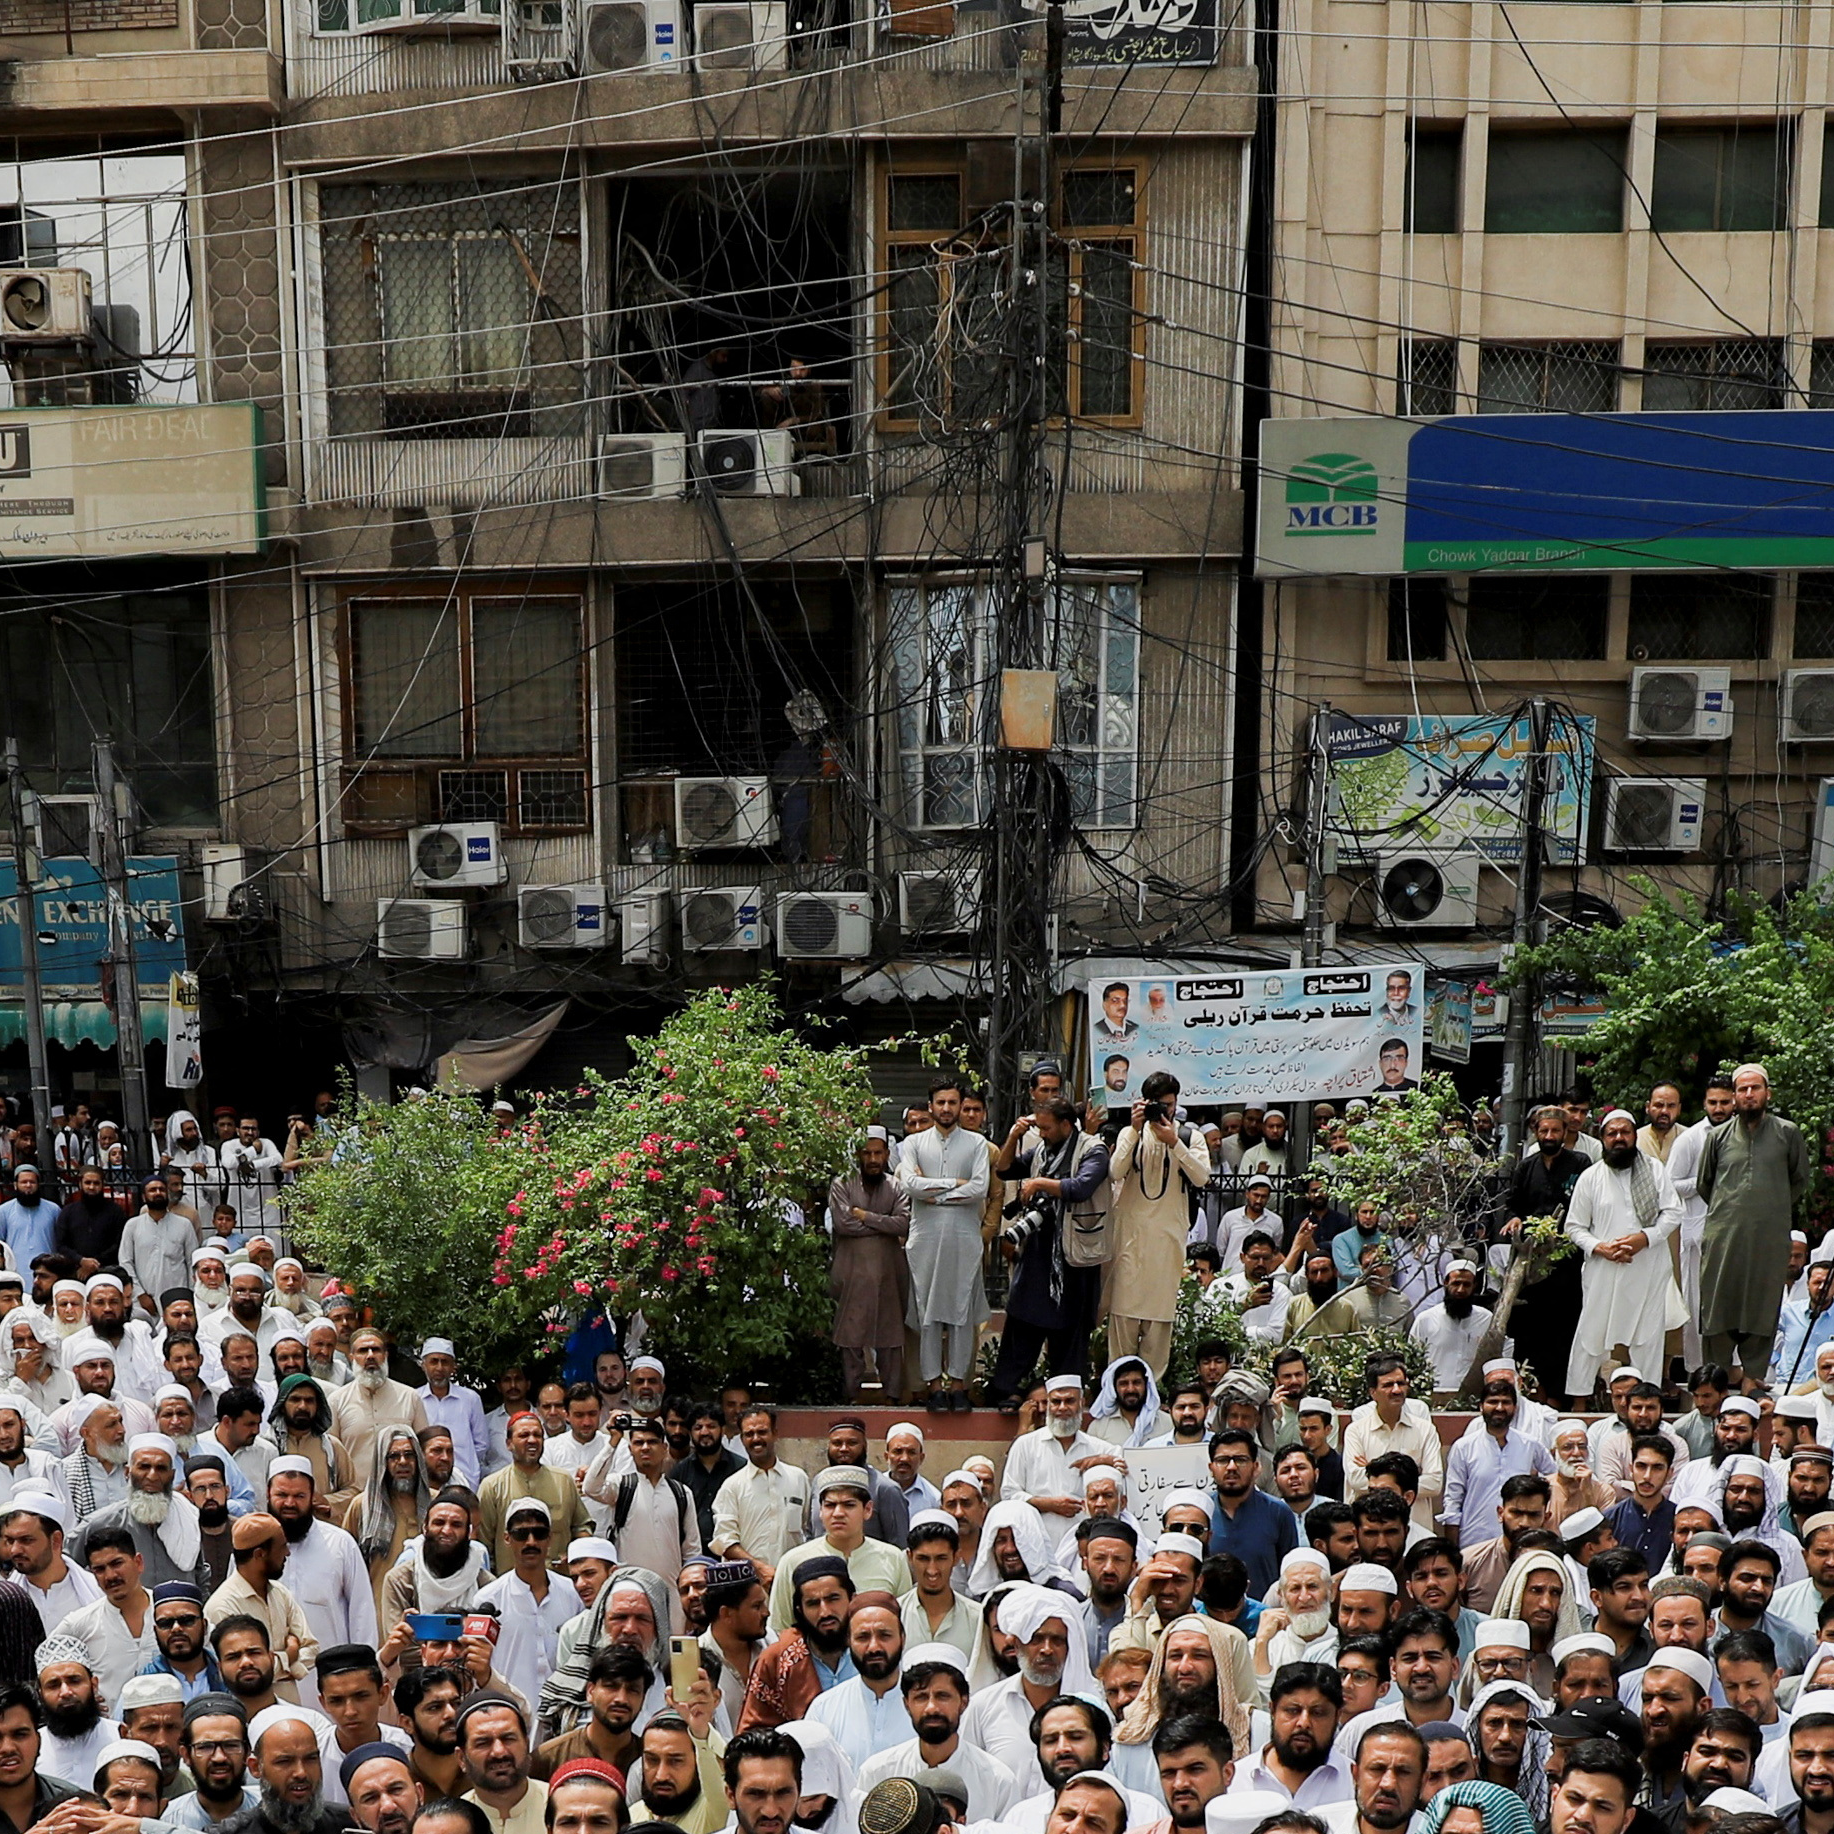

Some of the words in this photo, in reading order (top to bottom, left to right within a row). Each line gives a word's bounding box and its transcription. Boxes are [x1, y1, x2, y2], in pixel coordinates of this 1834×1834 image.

[81, 416, 137, 441] FAIR
[1286, 505, 1378, 528] MCB
[1427, 548, 1477, 563] Chowk
[1482, 548, 1531, 566] Yadgar
[1535, 547, 1586, 562] Branch
[1703, 697, 1722, 706] Haier
[1327, 724, 1362, 744] HAKIL
[1679, 809, 1697, 818] Haier
[468, 845, 490, 855] Haier
[44, 899, 173, 925] EXCHNGE
[1179, 981, 1240, 999] احتجاج
[1306, 974, 1368, 994] احتجاج
[1184, 1008, 1224, 1028] ریلی
[1228, 1004, 1267, 1026] قرآن
[1271, 1005, 1325, 1024] حرمت
[1331, 1001, 1372, 1018] تحفظ
[1146, 1042, 1167, 1057] شدید
[1216, 1039, 1234, 1058] پاک
[1234, 1038, 1258, 1054] قرآن
[1318, 1038, 1332, 1052] میں
[1359, 1036, 1370, 1053] ہم
[1209, 1066, 1223, 1079] ہیں
[1225, 1060, 1246, 1076] کرتے
[1288, 1062, 1307, 1073] الفاظ
[1346, 1066, 1376, 1087] اشتیاق
[1298, 1078, 1317, 1093] جنرل
[1323, 1071, 1345, 1092] پراچہ
